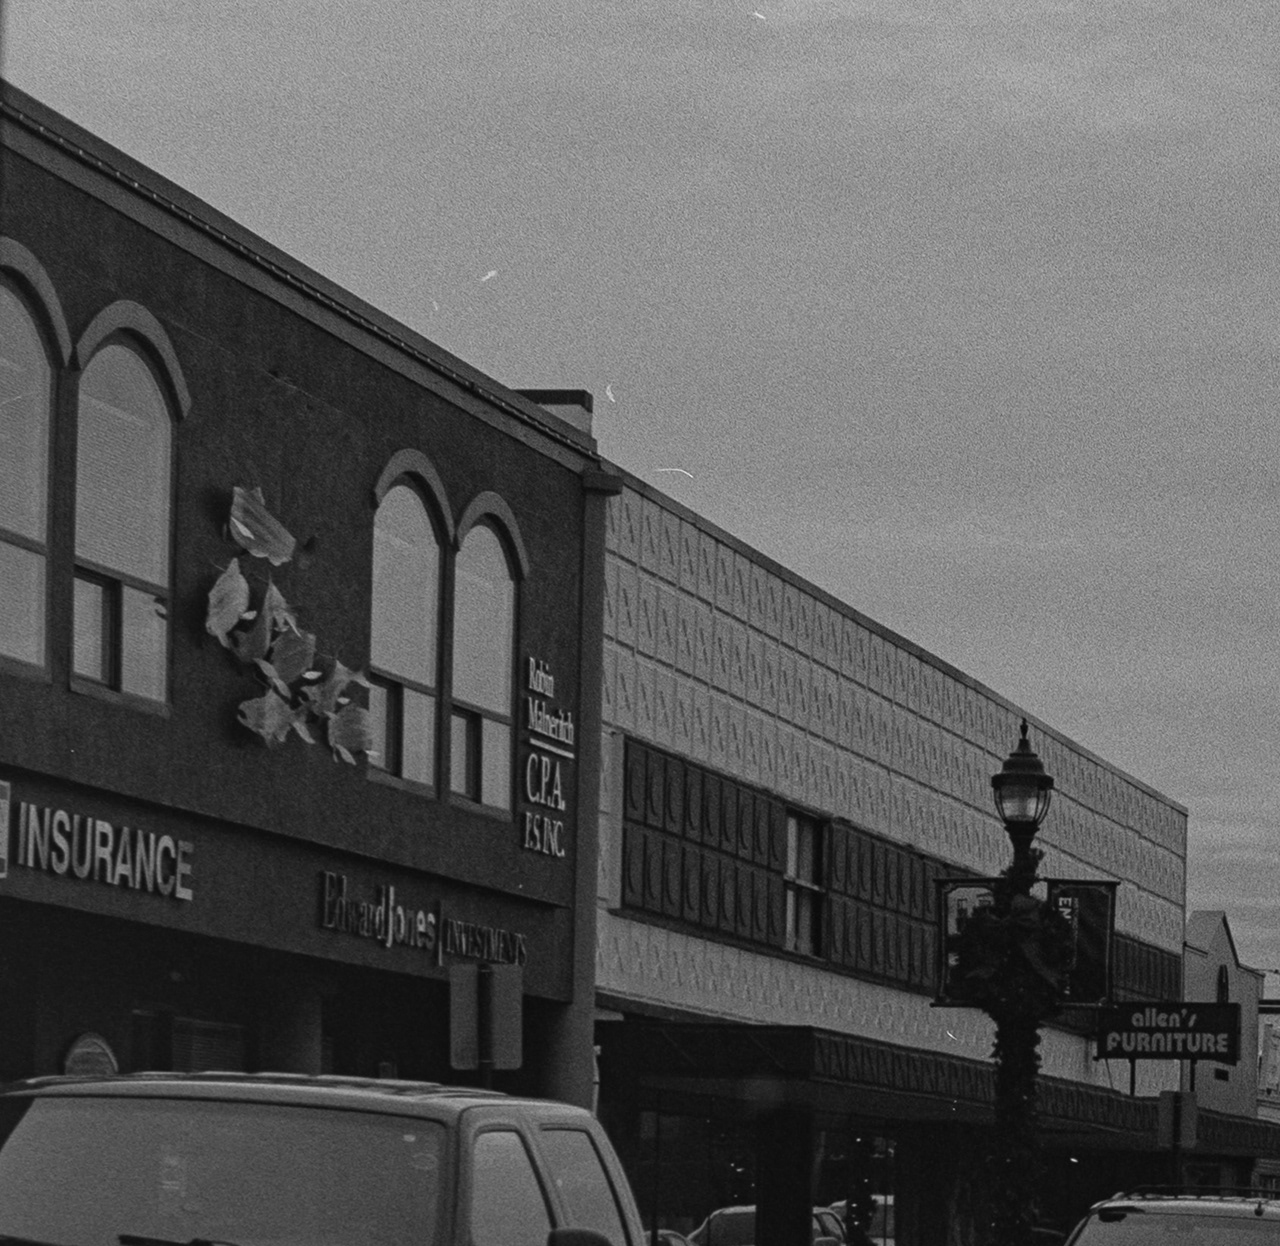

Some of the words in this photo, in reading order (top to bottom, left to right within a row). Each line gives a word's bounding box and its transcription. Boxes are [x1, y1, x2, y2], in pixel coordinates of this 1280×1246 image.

[526, 753, 566, 811] C.P.A.
[18, 801, 195, 901] INSURANCE
[1131, 1007, 1198, 1028] allen's
[1106, 1031, 1229, 1053] FURNITURE
